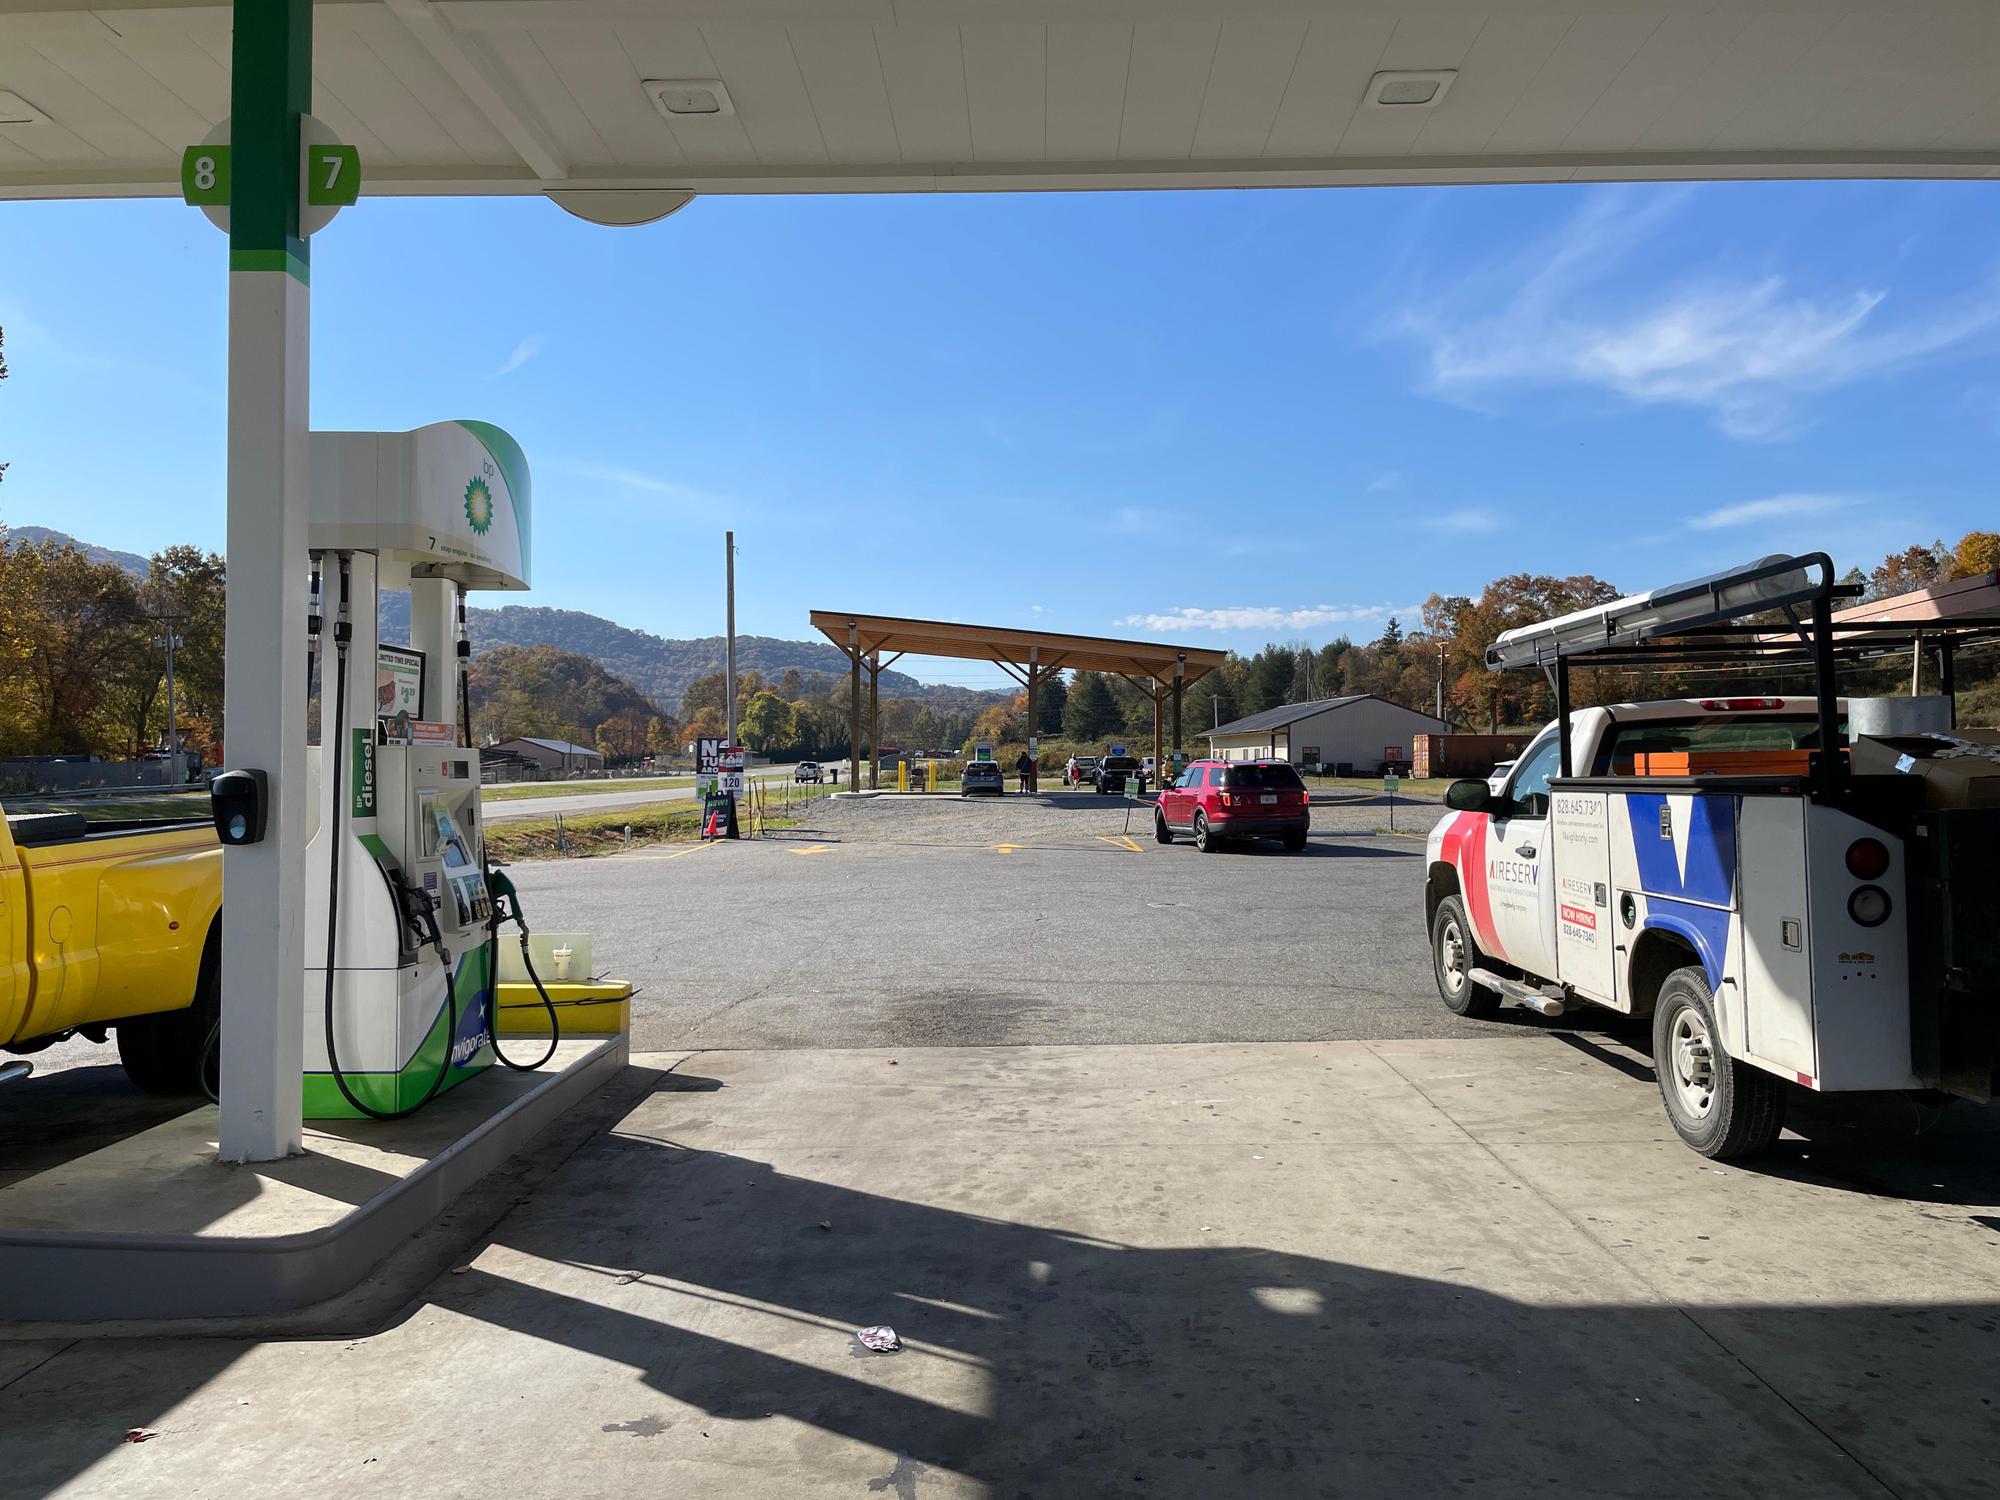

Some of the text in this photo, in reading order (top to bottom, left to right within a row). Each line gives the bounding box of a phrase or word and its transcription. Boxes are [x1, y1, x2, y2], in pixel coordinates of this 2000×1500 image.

[194, 156, 216, 190] 8
[322, 156, 343, 189] 7
[483, 457, 494, 480] bp
[429, 536, 436, 550] 7
[361, 734, 374, 808] diesel
[701, 756, 718, 767] TU
[1562, 906, 1594, 927] NOW HIRING
[451, 1028, 490, 1061] nvigorate
